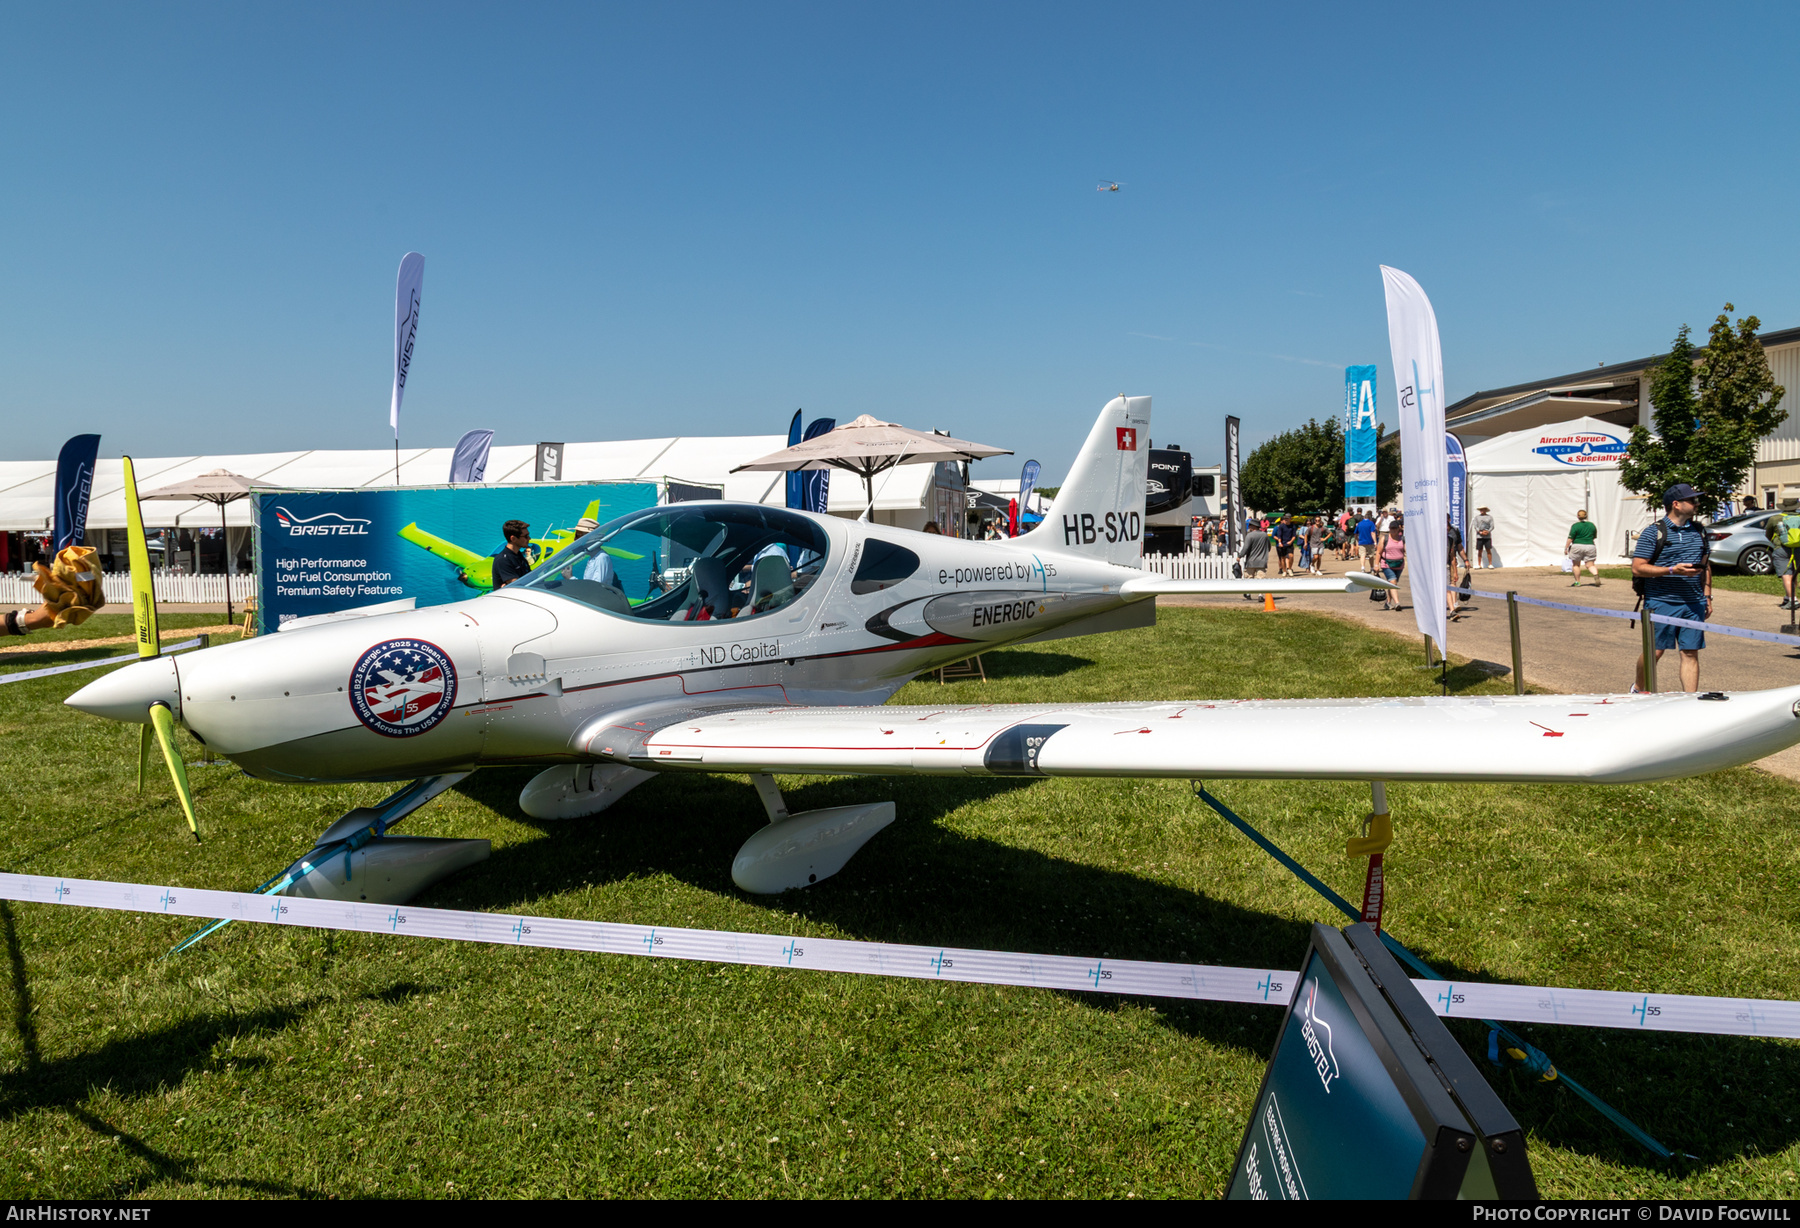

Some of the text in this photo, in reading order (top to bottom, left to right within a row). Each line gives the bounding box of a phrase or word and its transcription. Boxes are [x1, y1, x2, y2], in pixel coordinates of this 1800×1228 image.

[1356, 380, 1377, 429] A
[1540, 435, 1607, 444] Aircraft Spruce
[1151, 463, 1180, 472] POINT
[1575, 454, 1618, 462] Specialty
[74, 466, 94, 540] BRISTELL
[1452, 476, 1461, 528] rcraft Spruce
[289, 523, 369, 536] BRISTELL
[1063, 511, 1141, 546] HB-SXD
[276, 557, 367, 571] High Performance
[938, 562, 1013, 587] e-powered
[1016, 561, 1031, 583] by
[276, 570, 392, 584] Low Fuel Consumption
[276, 584, 403, 598] Premium Safety Features
[972, 600, 1036, 627] ENERGIC
[140, 625, 148, 643] DUC
[389, 640, 411, 649] 2025
[700, 640, 781, 666] ND Capital
[353, 648, 382, 718] Bristell B23 Energic
[374, 716, 438, 735] Across The USA
[1366, 866, 1382, 919] REMOVE
[1301, 1019, 1331, 1094] BRISTELL
